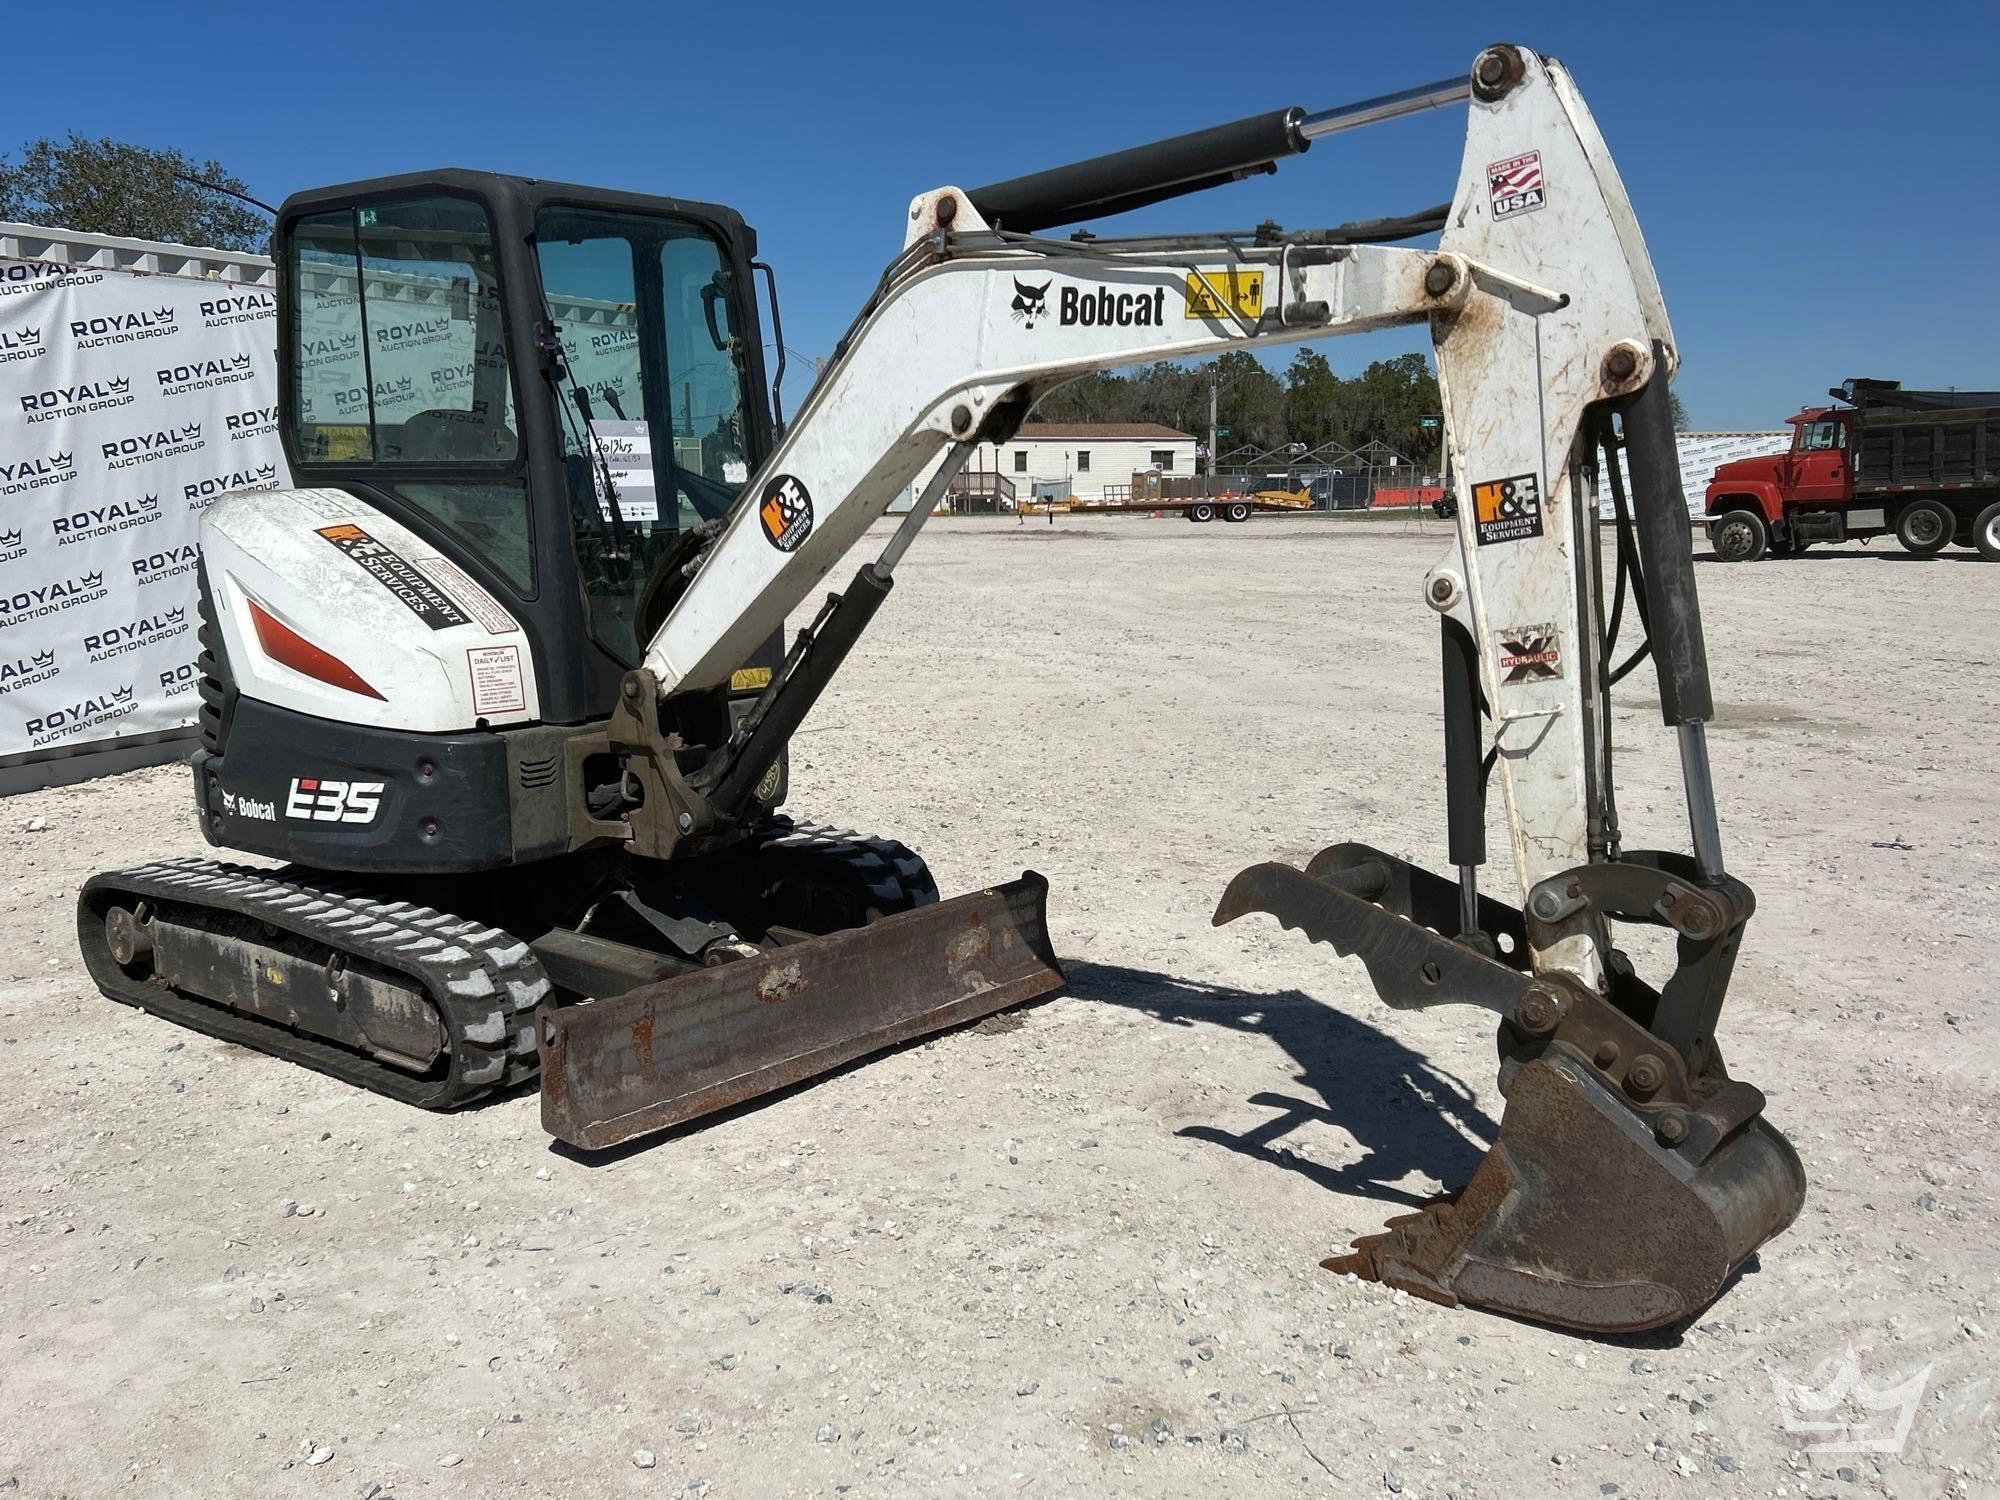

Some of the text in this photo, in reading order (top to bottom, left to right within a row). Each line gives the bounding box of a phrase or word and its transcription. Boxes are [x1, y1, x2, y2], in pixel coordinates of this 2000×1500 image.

[1495, 191, 1540, 213] USA
[0, 275, 104, 296] UCTION GROUP
[199, 293, 273, 317] ROYAL
[1060, 286, 1164, 326] Bobcat
[70, 311, 156, 338] ROYAL
[204, 313, 255, 328] AUCTION
[376, 320, 436, 343] ROYAL
[77, 325, 179, 350] AUCTION GROUP
[381, 332, 453, 353] AUCTION GROUP
[591, 329, 636, 348] ROYAL
[325, 351, 360, 364] GROUP
[595, 345, 626, 357] AUCTION
[157, 358, 233, 385] ROYAL
[162, 371, 255, 397] AUCTION GROUP
[20, 382, 110, 412] ROYAL
[382, 392, 416, 406] GROUP
[434, 379, 473, 394] AUCTION
[26, 395, 135, 425] AUCTION GROUP
[102, 429, 183, 459] ROYAL
[231, 424, 279, 441] AUCTION
[107, 440, 206, 471] AUCTION GROUP
[30, 470, 78, 489] GROUP
[184, 470, 257, 500] ROYAL
[761, 478, 806, 540] H&E
[1475, 477, 1538, 523] H&E
[52, 501, 139, 535] ROYAL
[58, 511, 163, 547] AUCTION GROUP
[777, 507, 811, 547] EQUIPMENT
[1480, 516, 1538, 533] EQUIPMENT
[784, 519, 812, 551] SERVICES
[1486, 525, 1533, 542] SERVICES
[137, 564, 188, 587] AUCTION
[360, 557, 430, 613] SERVICES
[378, 554, 465, 623] EQUIPMENT
[0, 588, 109, 629] AUCTION GROUP
[83, 613, 167, 653] ROYAL
[89, 623, 189, 664] AUCTION GROUP
[474, 655, 514, 665] DAILY LIST
[1502, 652, 1557, 667] HYDRAULIC
[13, 667, 60, 691] GROUP
[25, 694, 115, 737] ROYAL
[32, 701, 139, 748] AUCTION GROUP
[238, 796, 277, 822] Bobcat
[285, 777, 385, 824] E35
